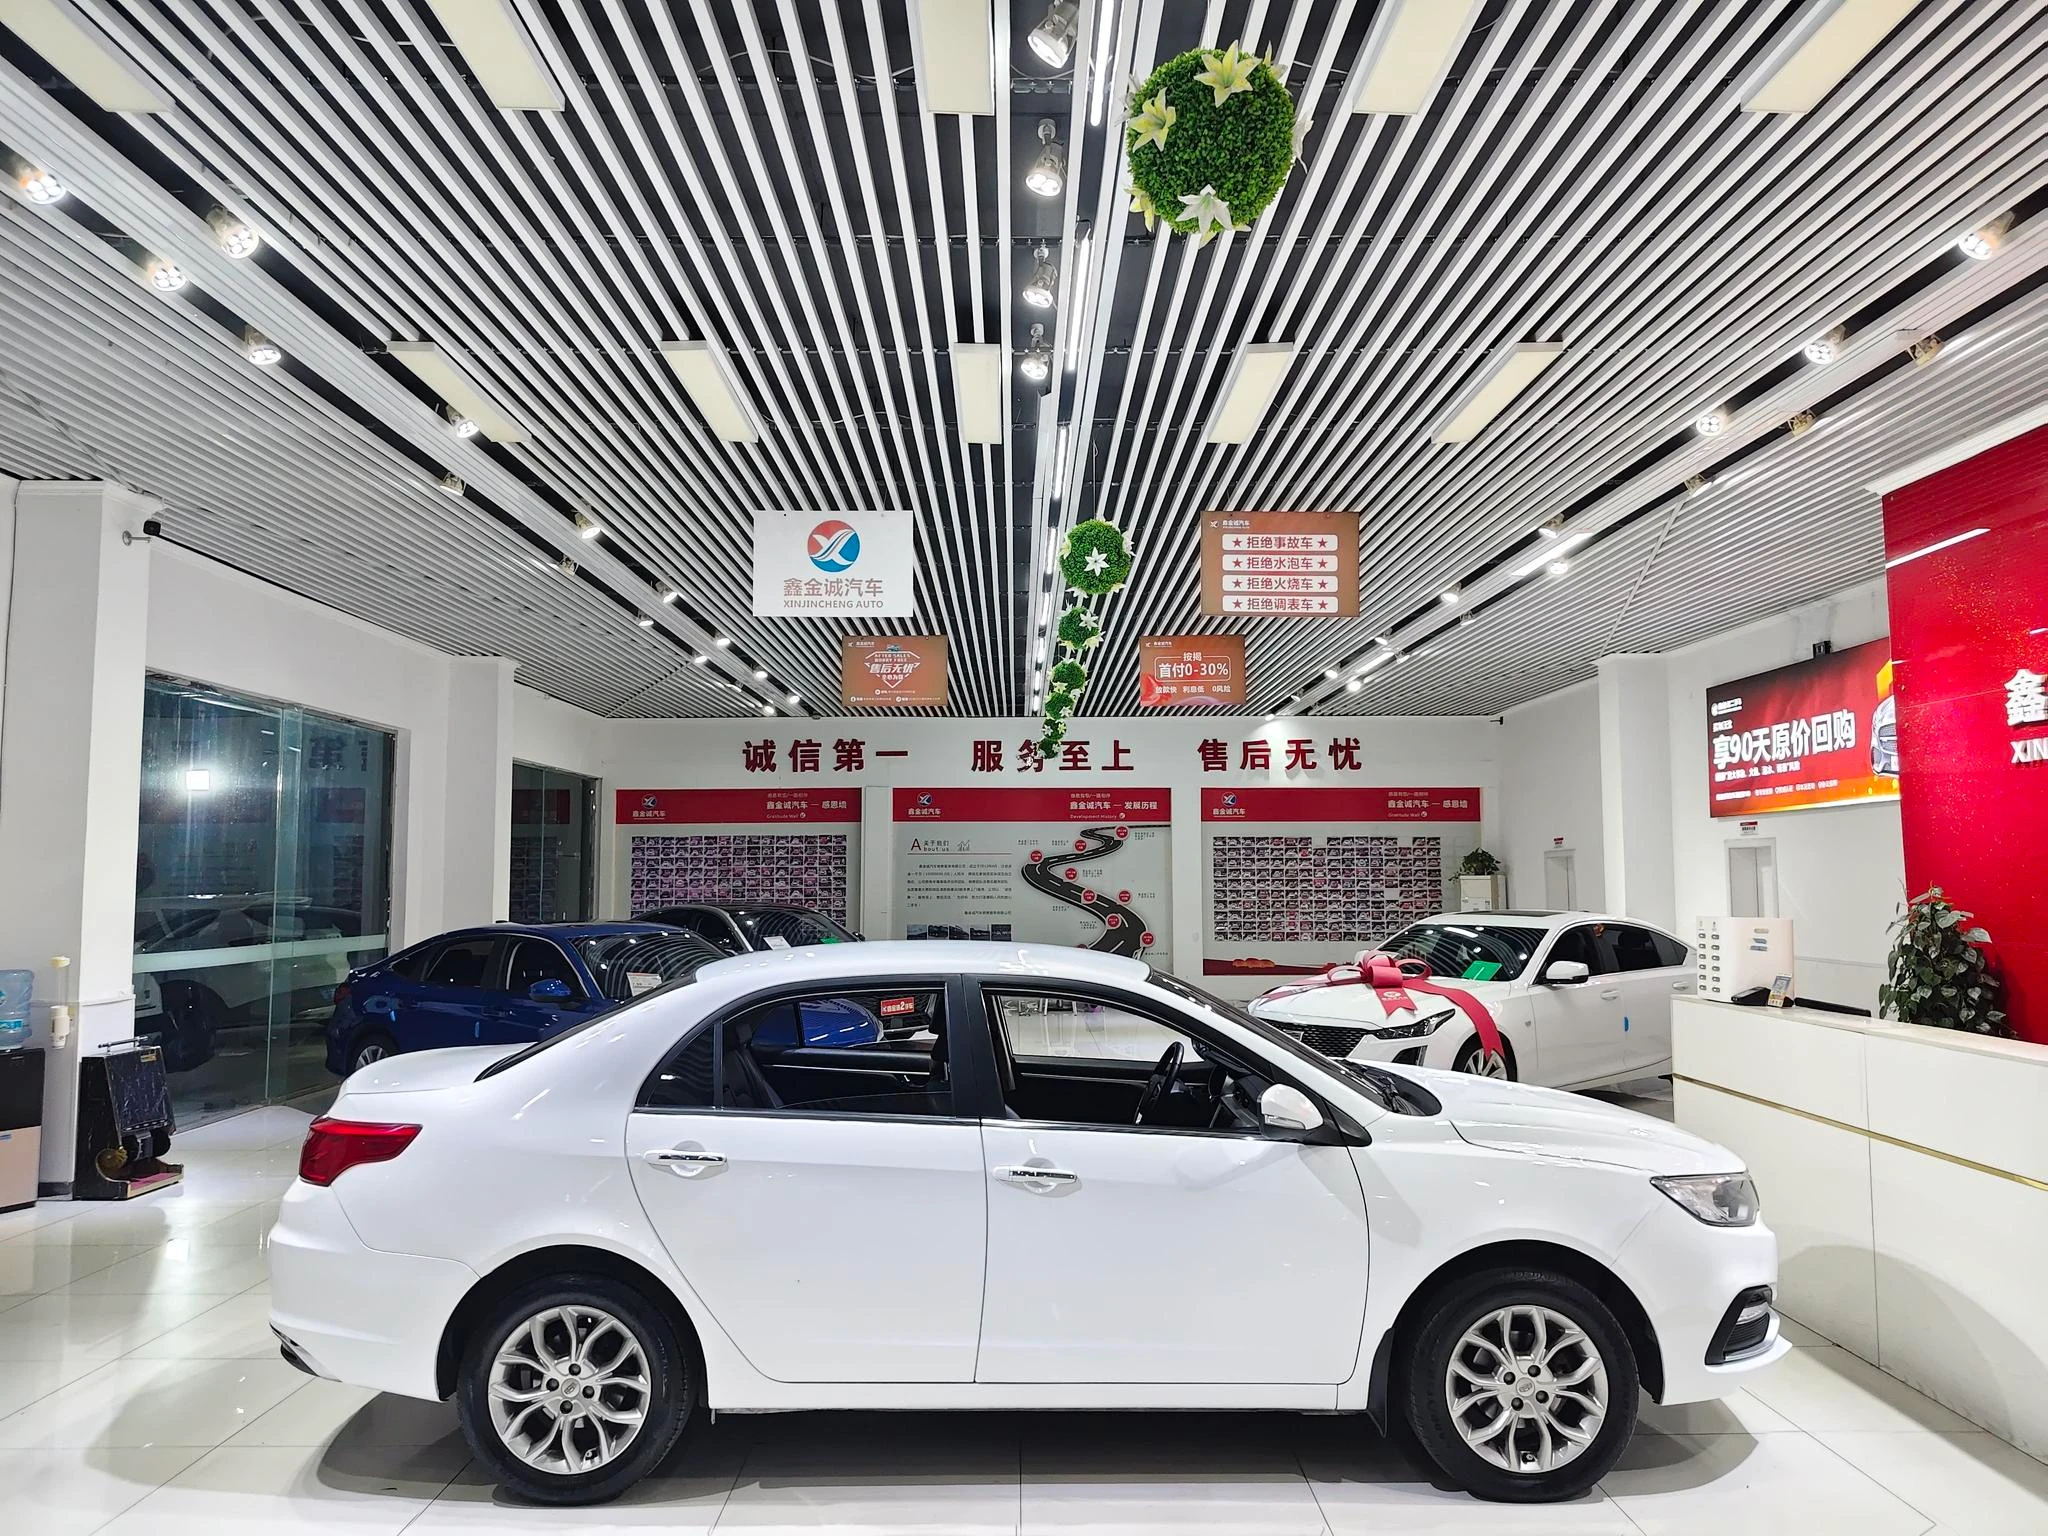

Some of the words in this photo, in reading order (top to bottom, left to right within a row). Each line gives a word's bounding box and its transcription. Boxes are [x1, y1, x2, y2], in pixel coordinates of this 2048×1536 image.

[1247, 536, 1313, 549] 拒绝事故车
[1247, 557, 1313, 570] 拒绝水泡车
[783, 577, 884, 597] 鑫金诚汽车
[1247, 577, 1313, 590] 拒绝火烧车
[783, 600, 854, 609] XINJINCHENG
[855, 600, 884, 609] AUTO
[1247, 598, 1313, 611] 拒绝调表车
[1183, 652, 1202, 662] 按揭
[870, 663, 914, 674] 售后无忧
[1158, 662, 1229, 678] 首付0-30%
[1712, 709, 1856, 770] 享90天原价回购
[742, 738, 909, 773] 诚信第一
[971, 739, 1135, 773] 服务至上
[1197, 738, 1363, 772] 售后无忧
